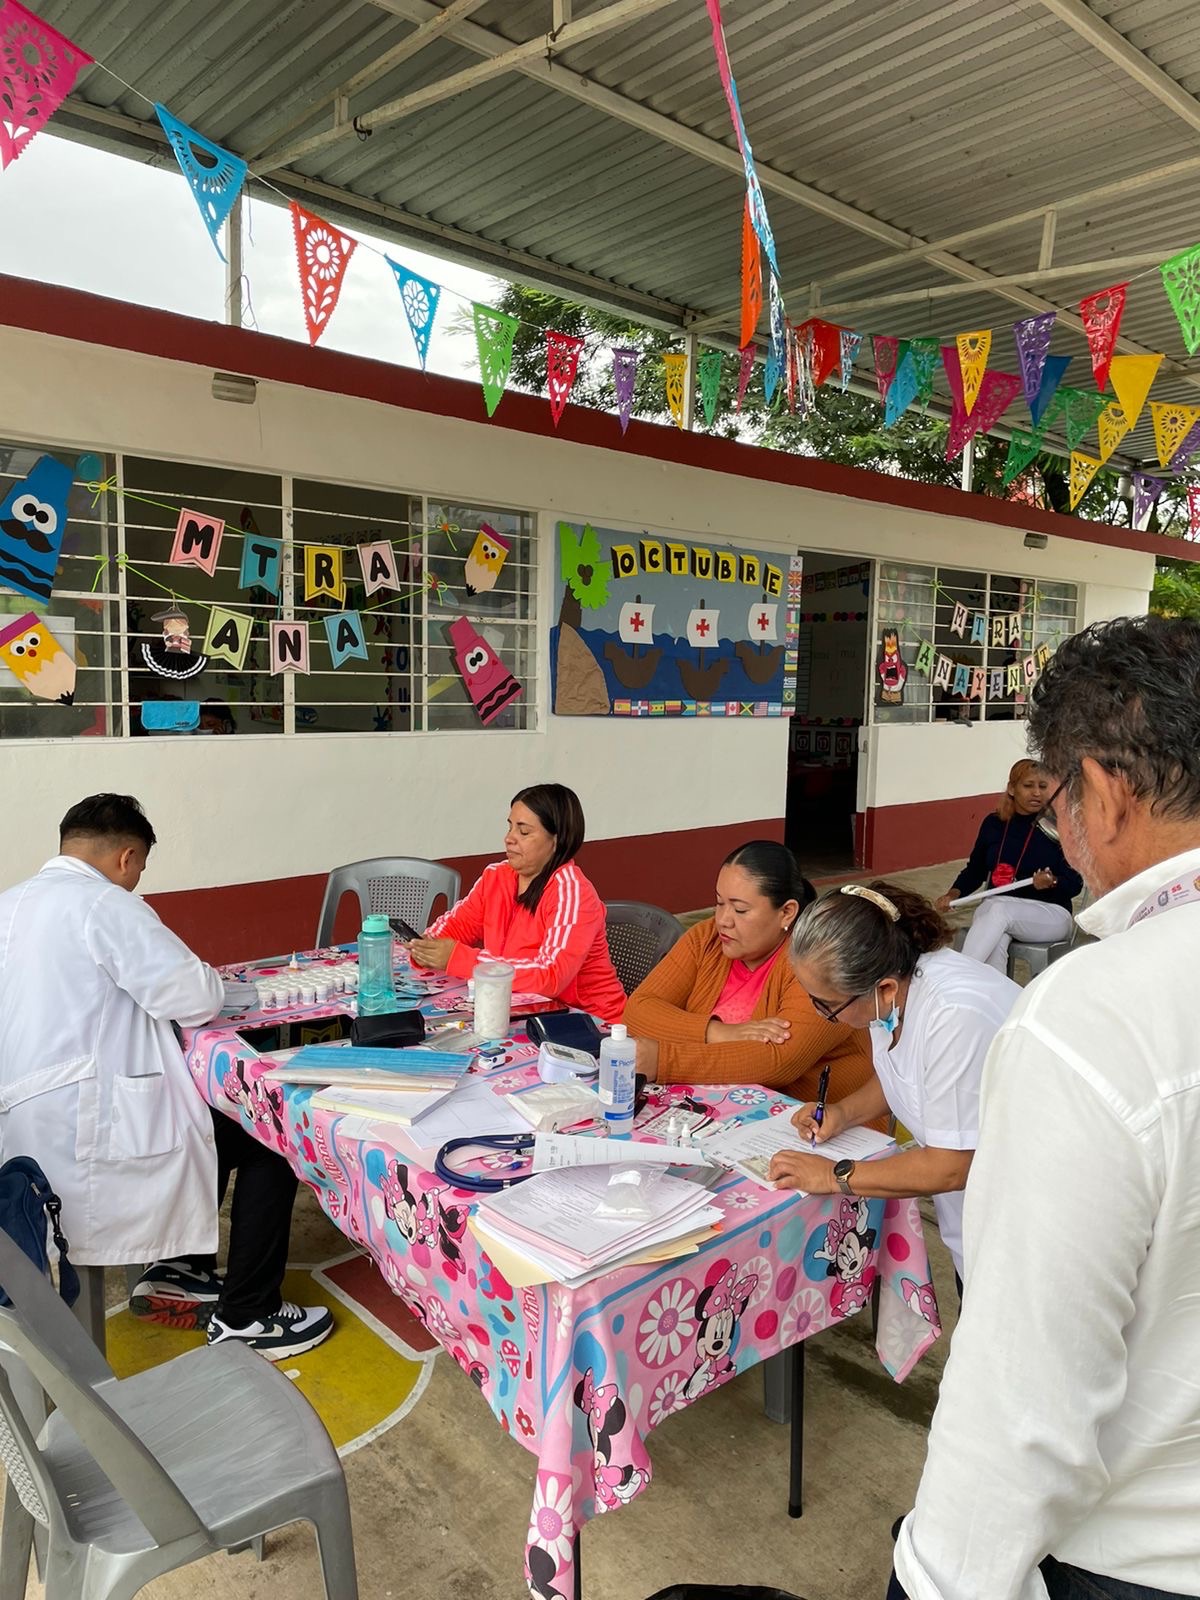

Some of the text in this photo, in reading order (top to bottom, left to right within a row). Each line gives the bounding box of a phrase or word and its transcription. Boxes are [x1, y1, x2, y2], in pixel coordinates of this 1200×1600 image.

[181, 519, 391, 589] MTRA
[619, 547, 782, 595] OCTUBRE
[211, 618, 359, 662] ANA
[953, 609, 1020, 639] MTRA
